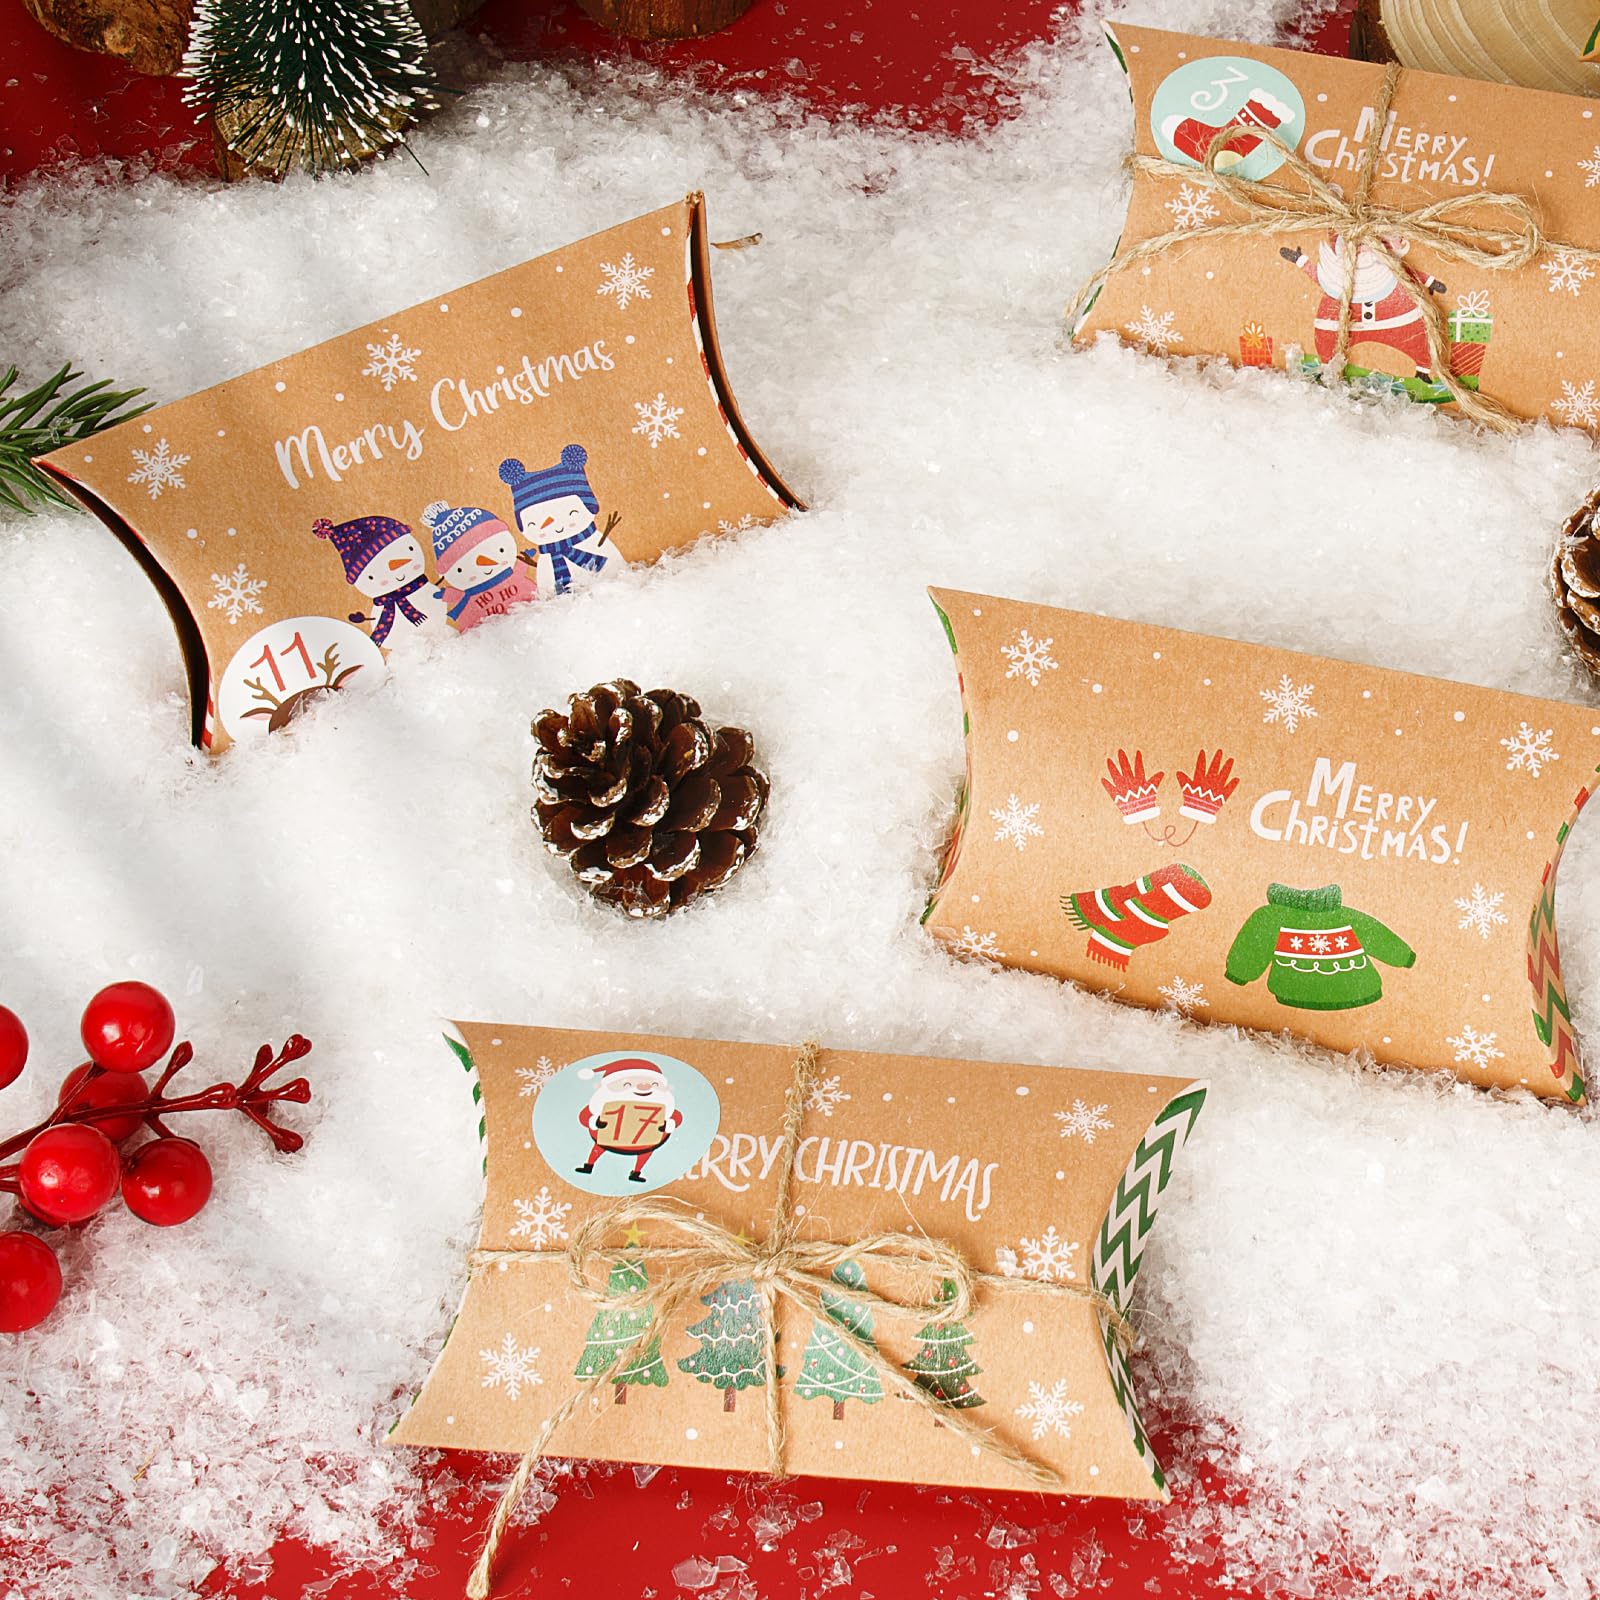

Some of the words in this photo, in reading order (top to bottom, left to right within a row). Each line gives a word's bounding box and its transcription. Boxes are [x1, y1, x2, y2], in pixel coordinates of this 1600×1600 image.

[1190, 66, 1249, 111] 3
[275, 420, 425, 490] Merry
[430, 340, 616, 432] Christmas
[475, 591, 494, 609] HO
[499, 584, 518, 601] HO
[486, 603, 505, 616] HO
[250, 631, 317, 692] 11
[605, 1104, 662, 1145] 17
[676, 1133, 786, 1193] RRY
[795, 1135, 999, 1222] CHRISTMAS
